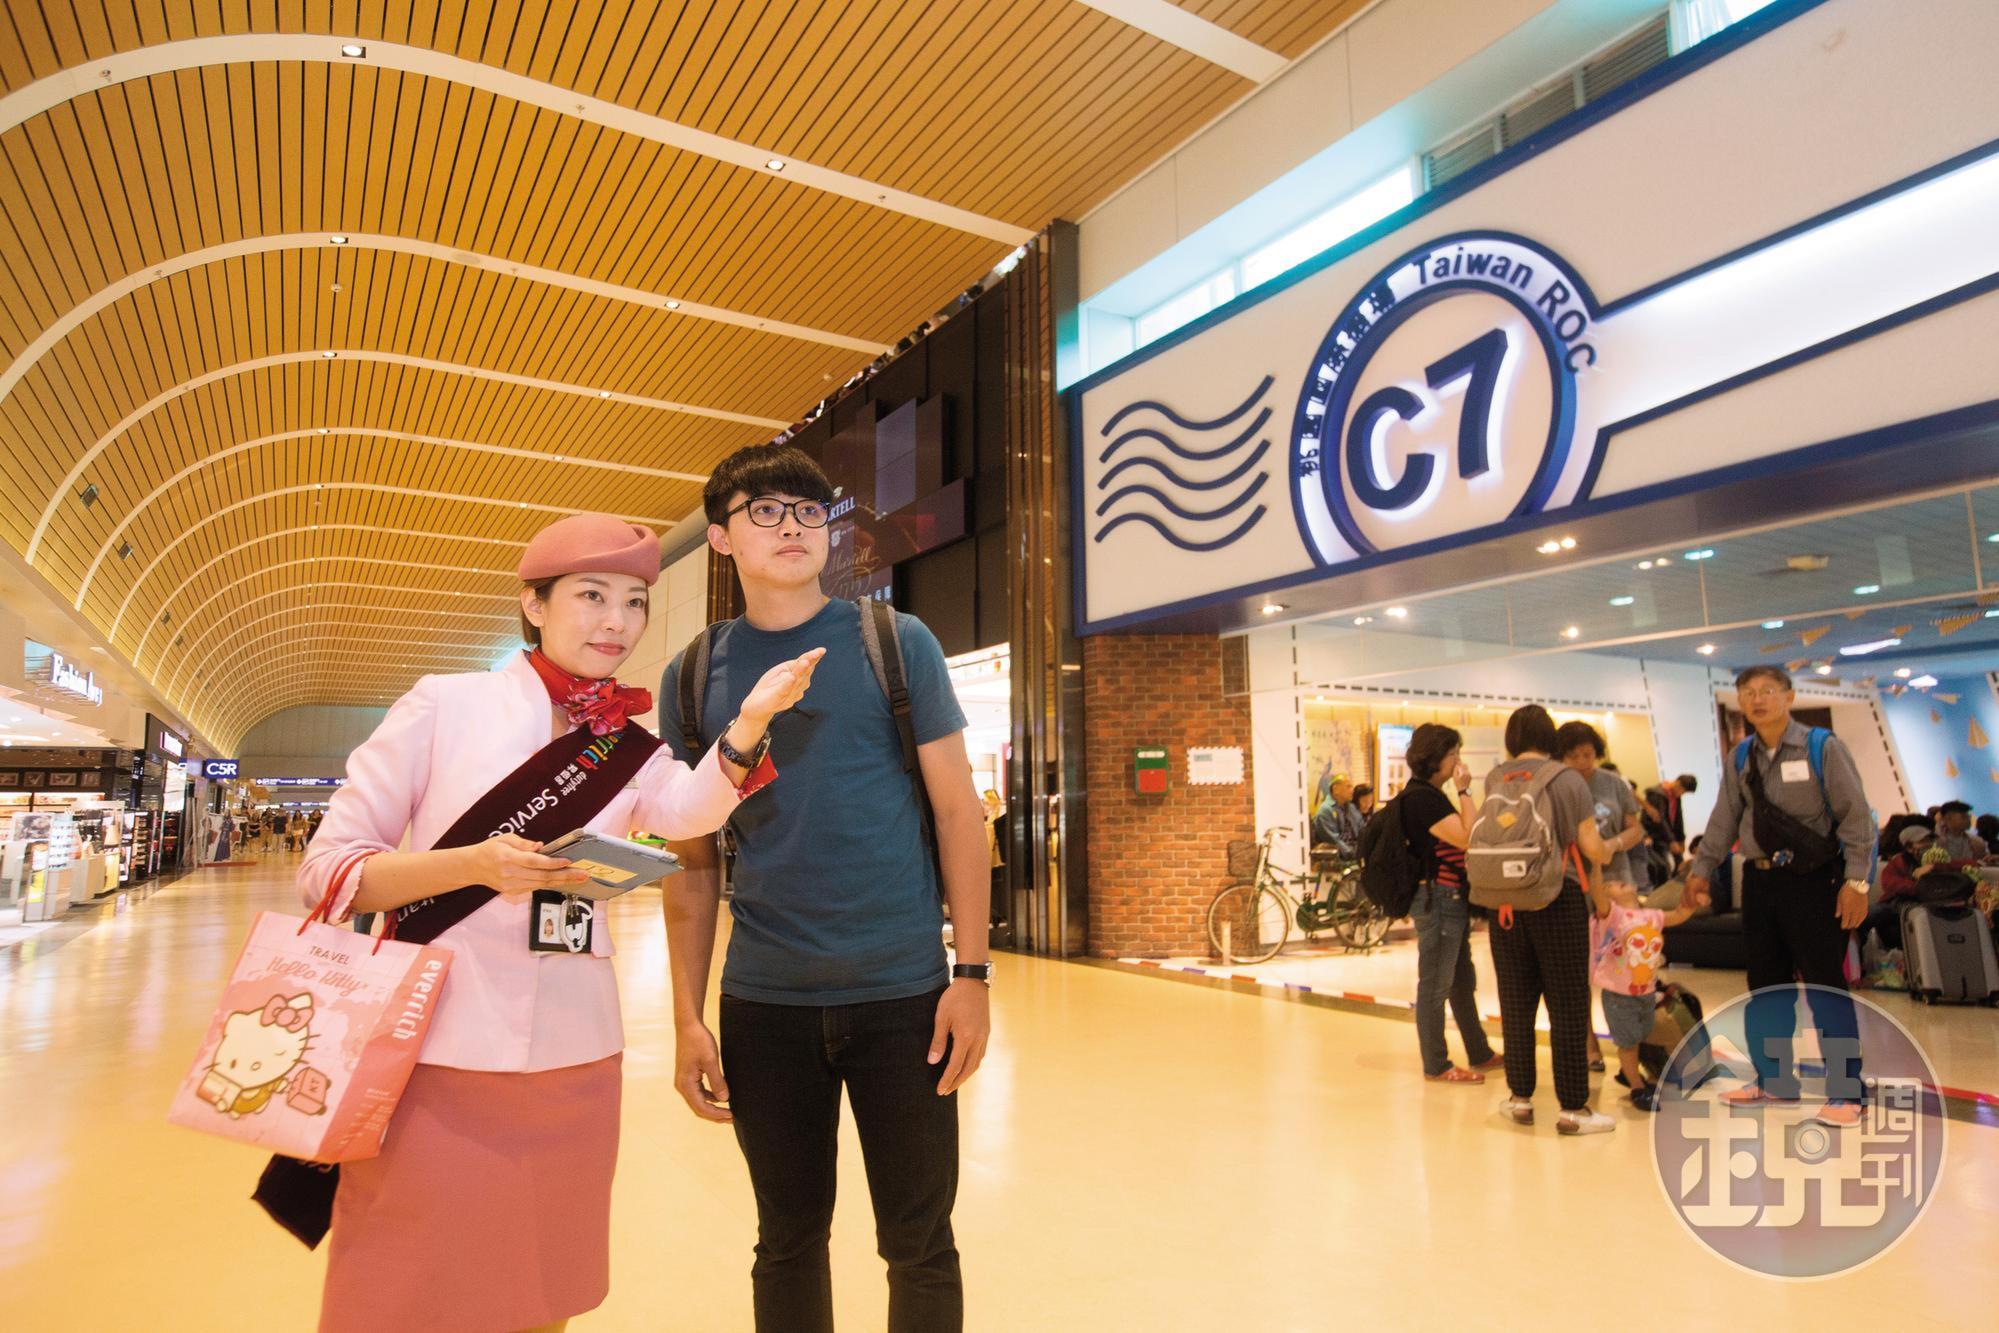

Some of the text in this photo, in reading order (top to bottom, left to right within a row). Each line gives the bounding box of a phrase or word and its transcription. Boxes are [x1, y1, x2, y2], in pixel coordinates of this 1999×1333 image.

[1412, 245, 1597, 373] Taiwan ROC
[1346, 328, 1509, 511] C7
[206, 762, 238, 776] C5R
[559, 770, 588, 797] dutyfree
[266, 955, 317, 980] Hello
[309, 945, 351, 966] TRAVEL
[391, 959, 443, 1041] everrich
